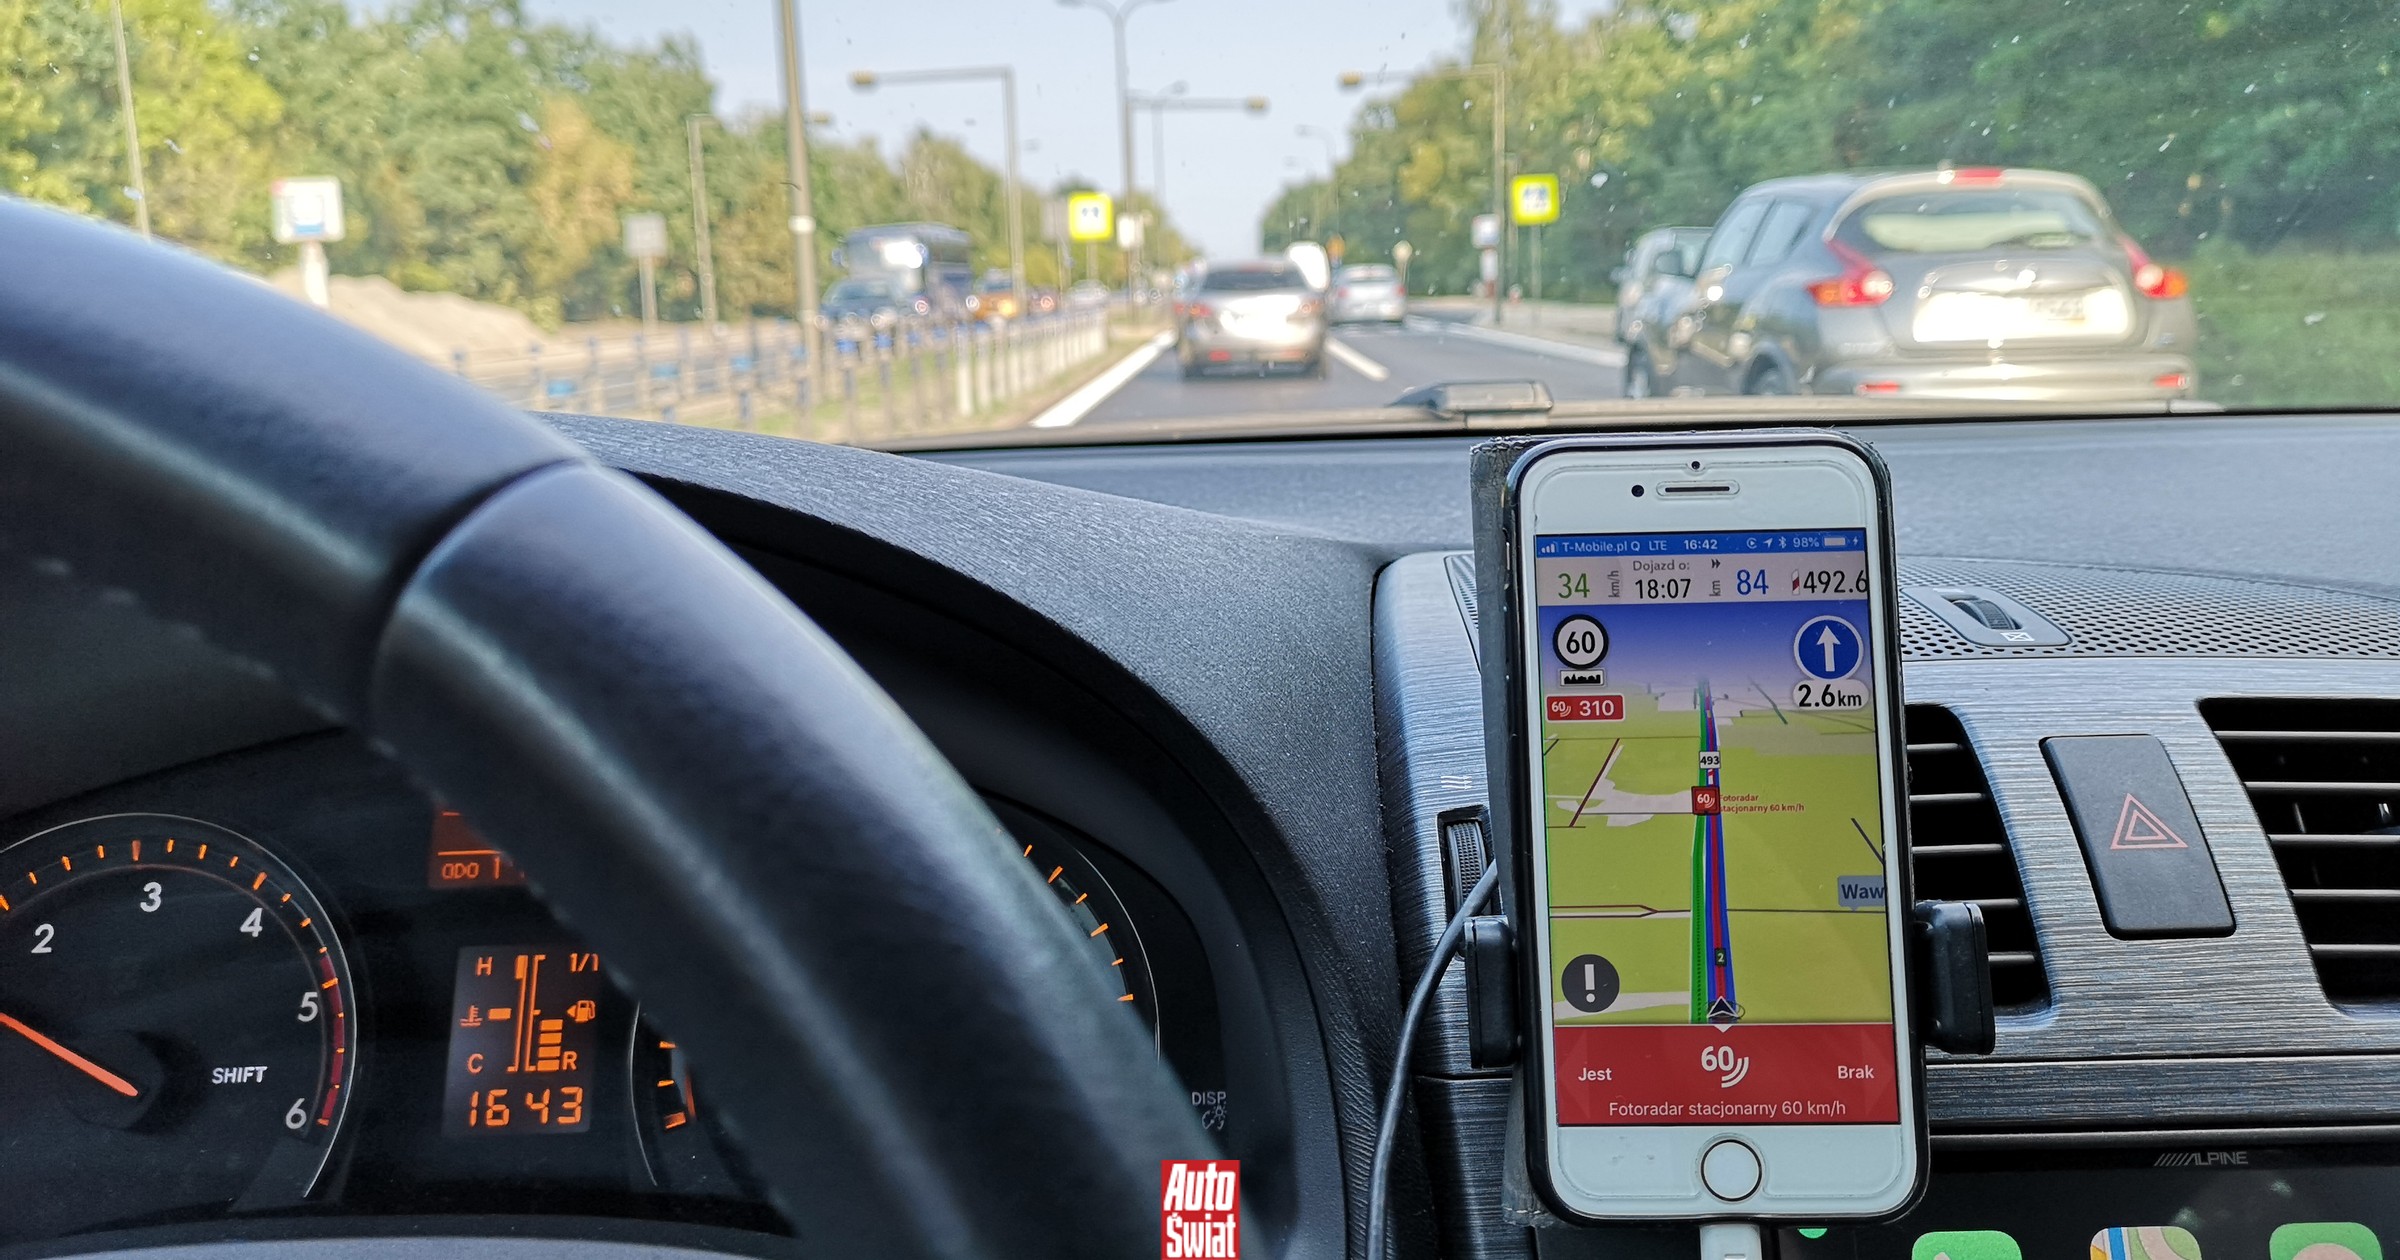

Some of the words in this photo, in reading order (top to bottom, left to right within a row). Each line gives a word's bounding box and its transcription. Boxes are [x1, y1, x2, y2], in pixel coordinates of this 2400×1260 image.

[1562, 540, 1628, 553] T-Mobile.pl
[1649, 540, 1667, 551] LTE
[1683, 539, 1718, 550] 16:42
[1793, 537, 1819, 548] 98%
[1633, 559, 1675, 573] Dojazd
[1679, 561, 1690, 571] o:
[1558, 572, 1590, 599] 34
[1608, 570, 1620, 598] km/h
[1635, 578, 1691, 599] 18:07
[1709, 580, 1721, 597] km
[1736, 569, 1769, 595] 84
[1803, 569, 1868, 594] 492.6
[1566, 631, 1595, 654] 60
[1551, 701, 1566, 713] 60
[1579, 700, 1614, 717] 310
[1700, 755, 1720, 765] 493
[1697, 793, 1710, 804] 60
[1781, 803, 1804, 812] km/h
[442, 862, 480, 880] ODO
[140, 881, 162, 913] 3
[1841, 883, 1885, 900] Waw
[240, 907, 263, 938] 4
[31, 923, 55, 954] 2
[475, 956, 493, 977] H
[570, 952, 599, 972] 1/1
[1717, 952, 1725, 963] 2
[297, 991, 319, 1023] 5
[467, 1053, 484, 1074] C
[562, 1050, 578, 1071] R
[1700, 1045, 1735, 1072] 60
[211, 1065, 269, 1085] SHIFT
[1578, 1066, 1613, 1081] Jest
[1837, 1064, 1875, 1080] Brak
[285, 1097, 308, 1130] 6
[1609, 1101, 1683, 1116] Fotoradar
[1688, 1101, 1776, 1118] stacjonarny
[1781, 1100, 1803, 1115] 60
[1807, 1099, 1846, 1116] km/h
[2183, 1151, 2249, 1166] ALPINE
